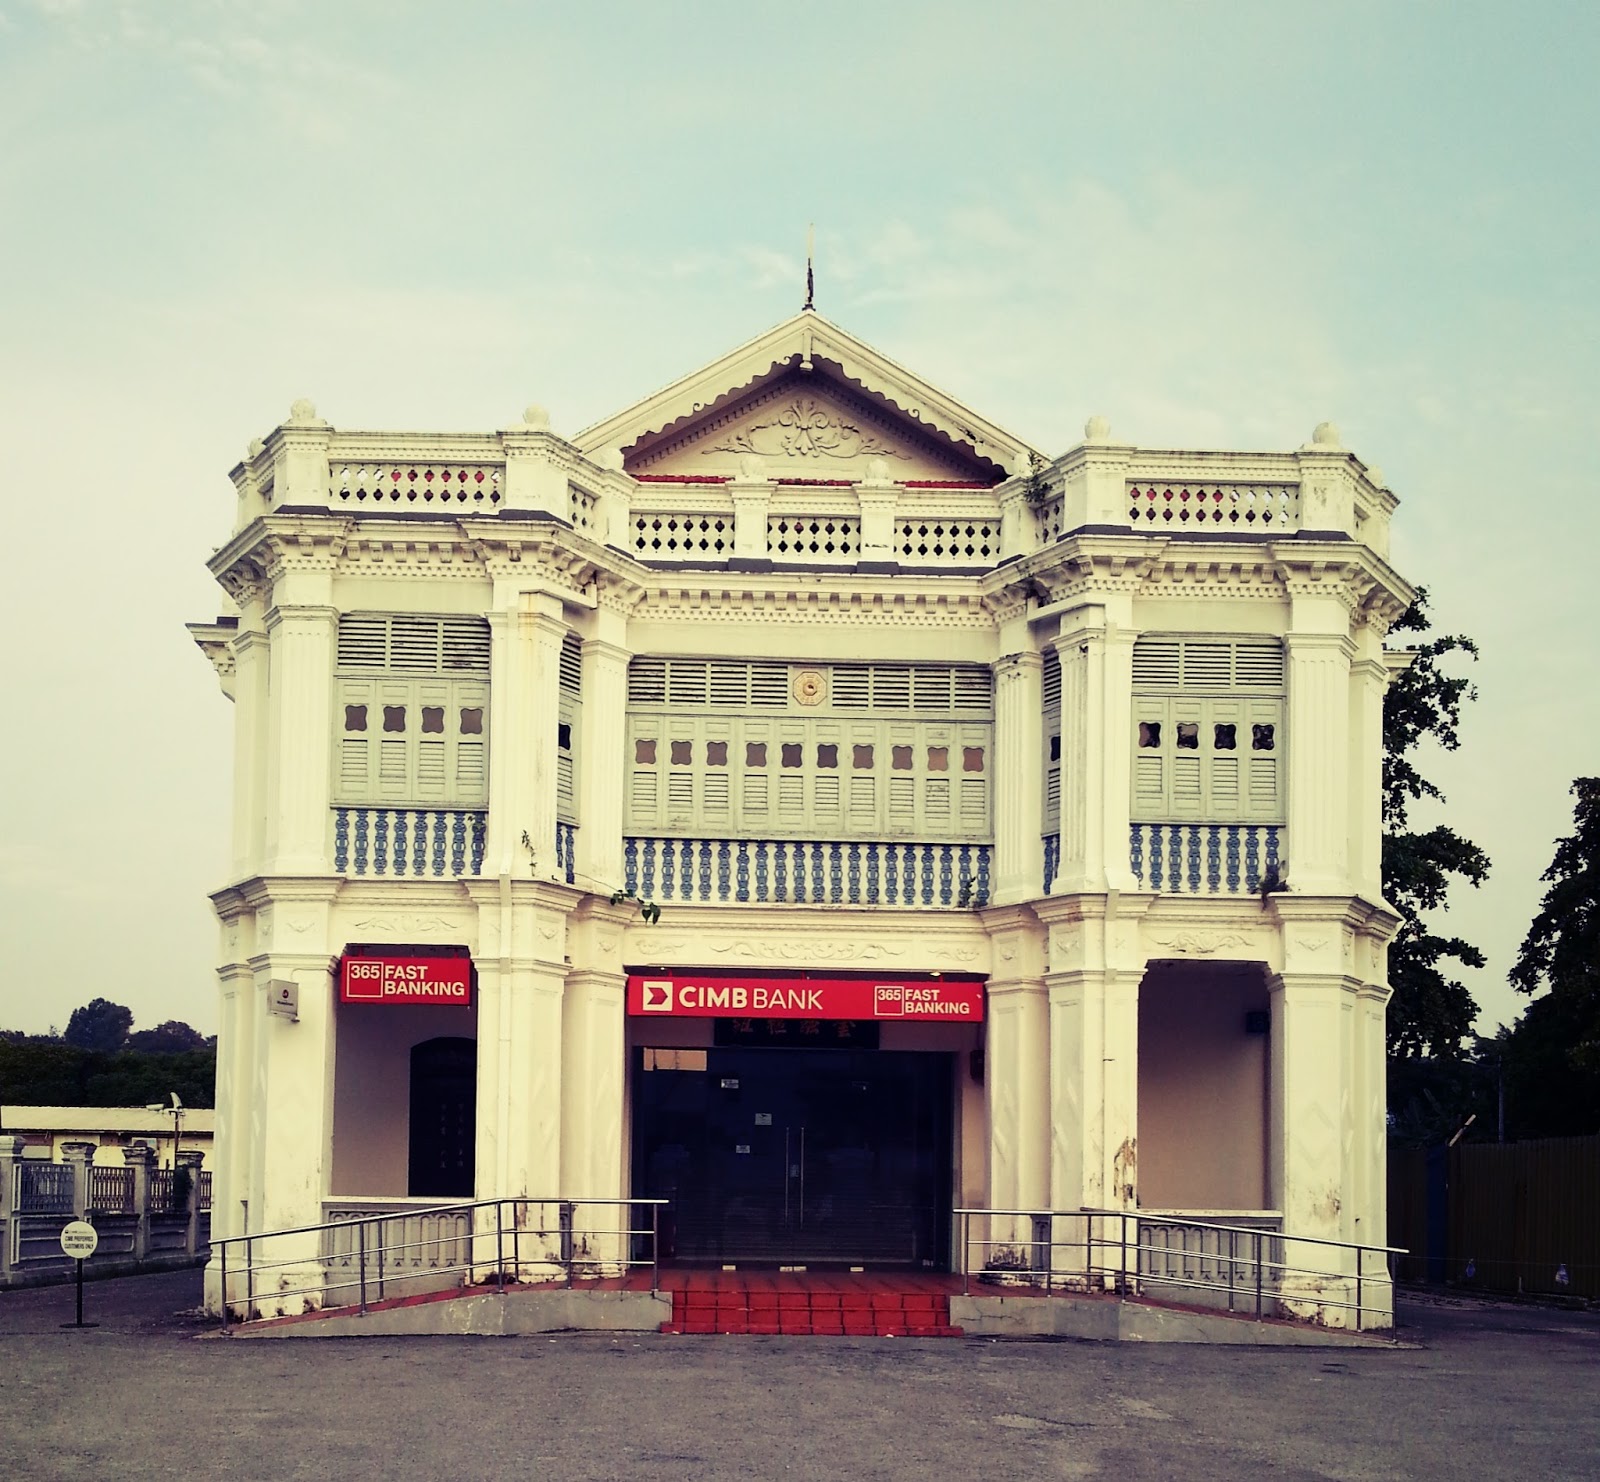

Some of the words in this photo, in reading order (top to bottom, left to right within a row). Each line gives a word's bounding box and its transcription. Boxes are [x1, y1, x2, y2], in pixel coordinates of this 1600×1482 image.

[350, 965, 380, 979] 365
[384, 965, 428, 980] FAST
[384, 981, 465, 996] BANKING
[877, 989, 901, 1001] 365
[905, 989, 940, 1001] FAST
[679, 986, 748, 1009] CIMB
[753, 987, 824, 1010] BANK
[905, 1002, 970, 1015] BANKING
